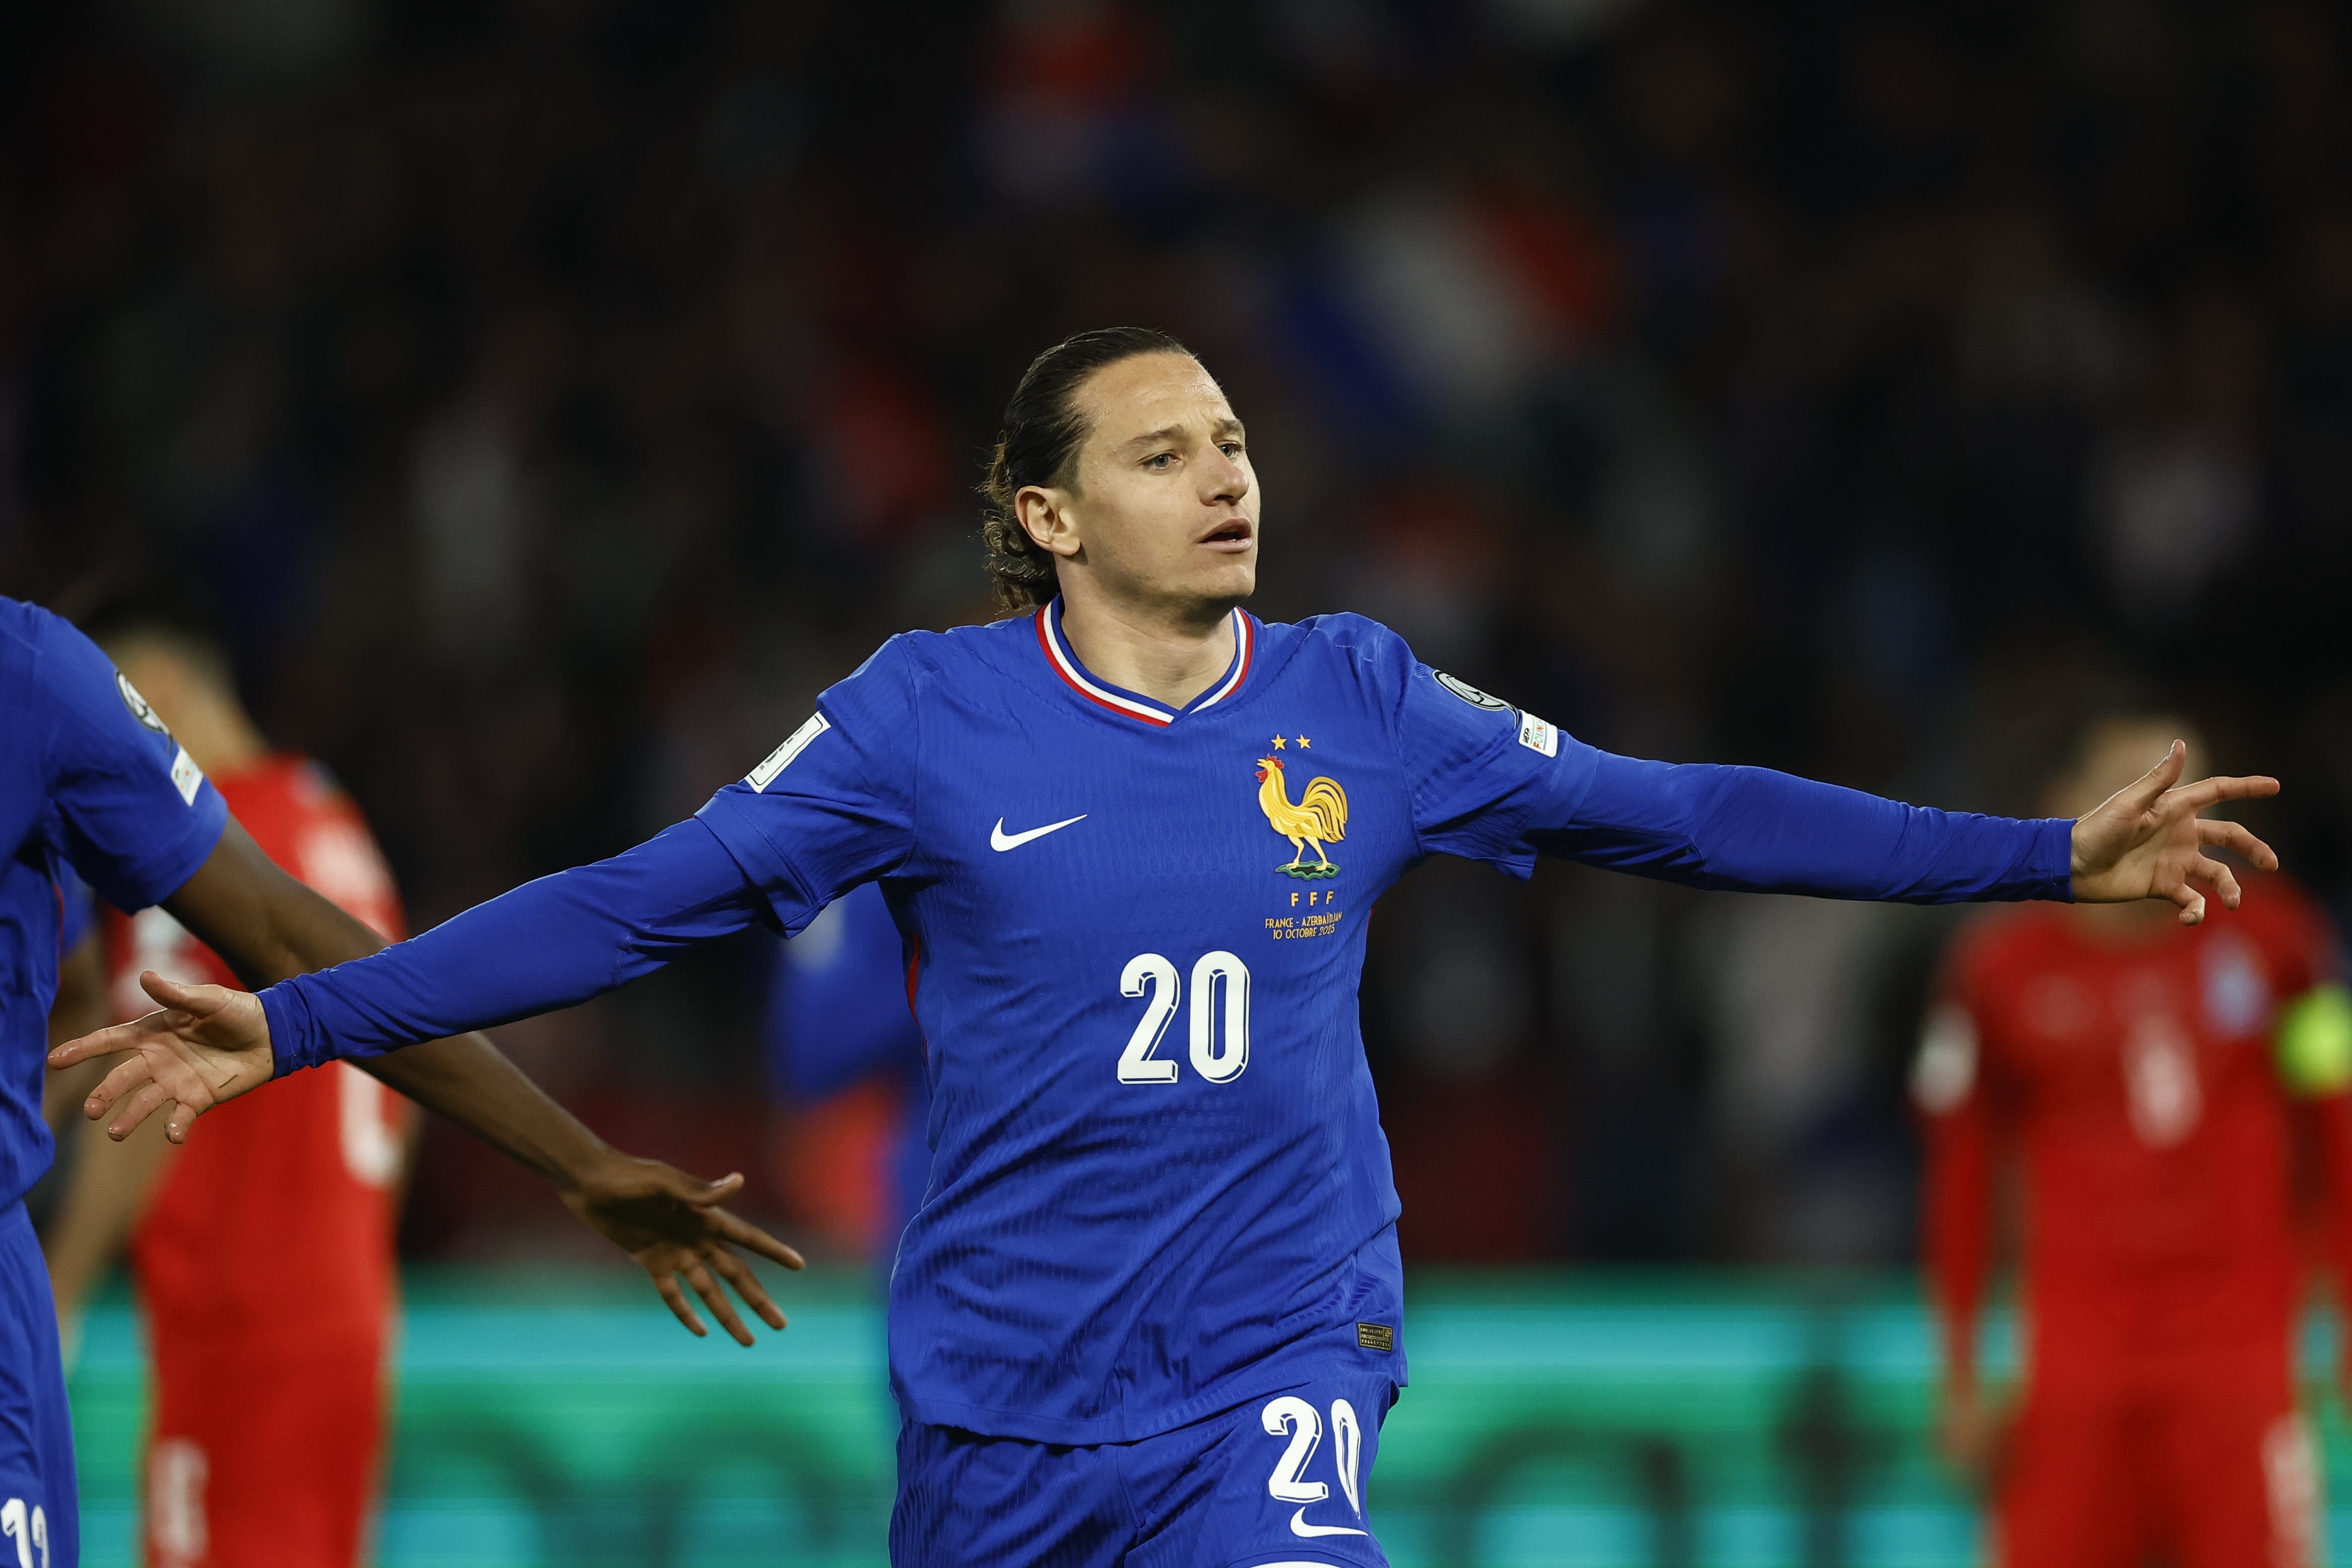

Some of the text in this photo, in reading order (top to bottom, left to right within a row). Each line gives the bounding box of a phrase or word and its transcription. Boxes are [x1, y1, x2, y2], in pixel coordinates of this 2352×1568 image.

[1522, 728, 1531, 743] UEFA
[1265, 917, 1294, 929] FRANCE
[1302, 911, 1343, 927] AZERBAÏDJAN
[1273, 924, 1335, 940] 10 OCTOBRE 2025
[1117, 950, 1250, 1084] 20
[1262, 1396, 1361, 1520] 20
[1, 1497, 50, 1568] 19
